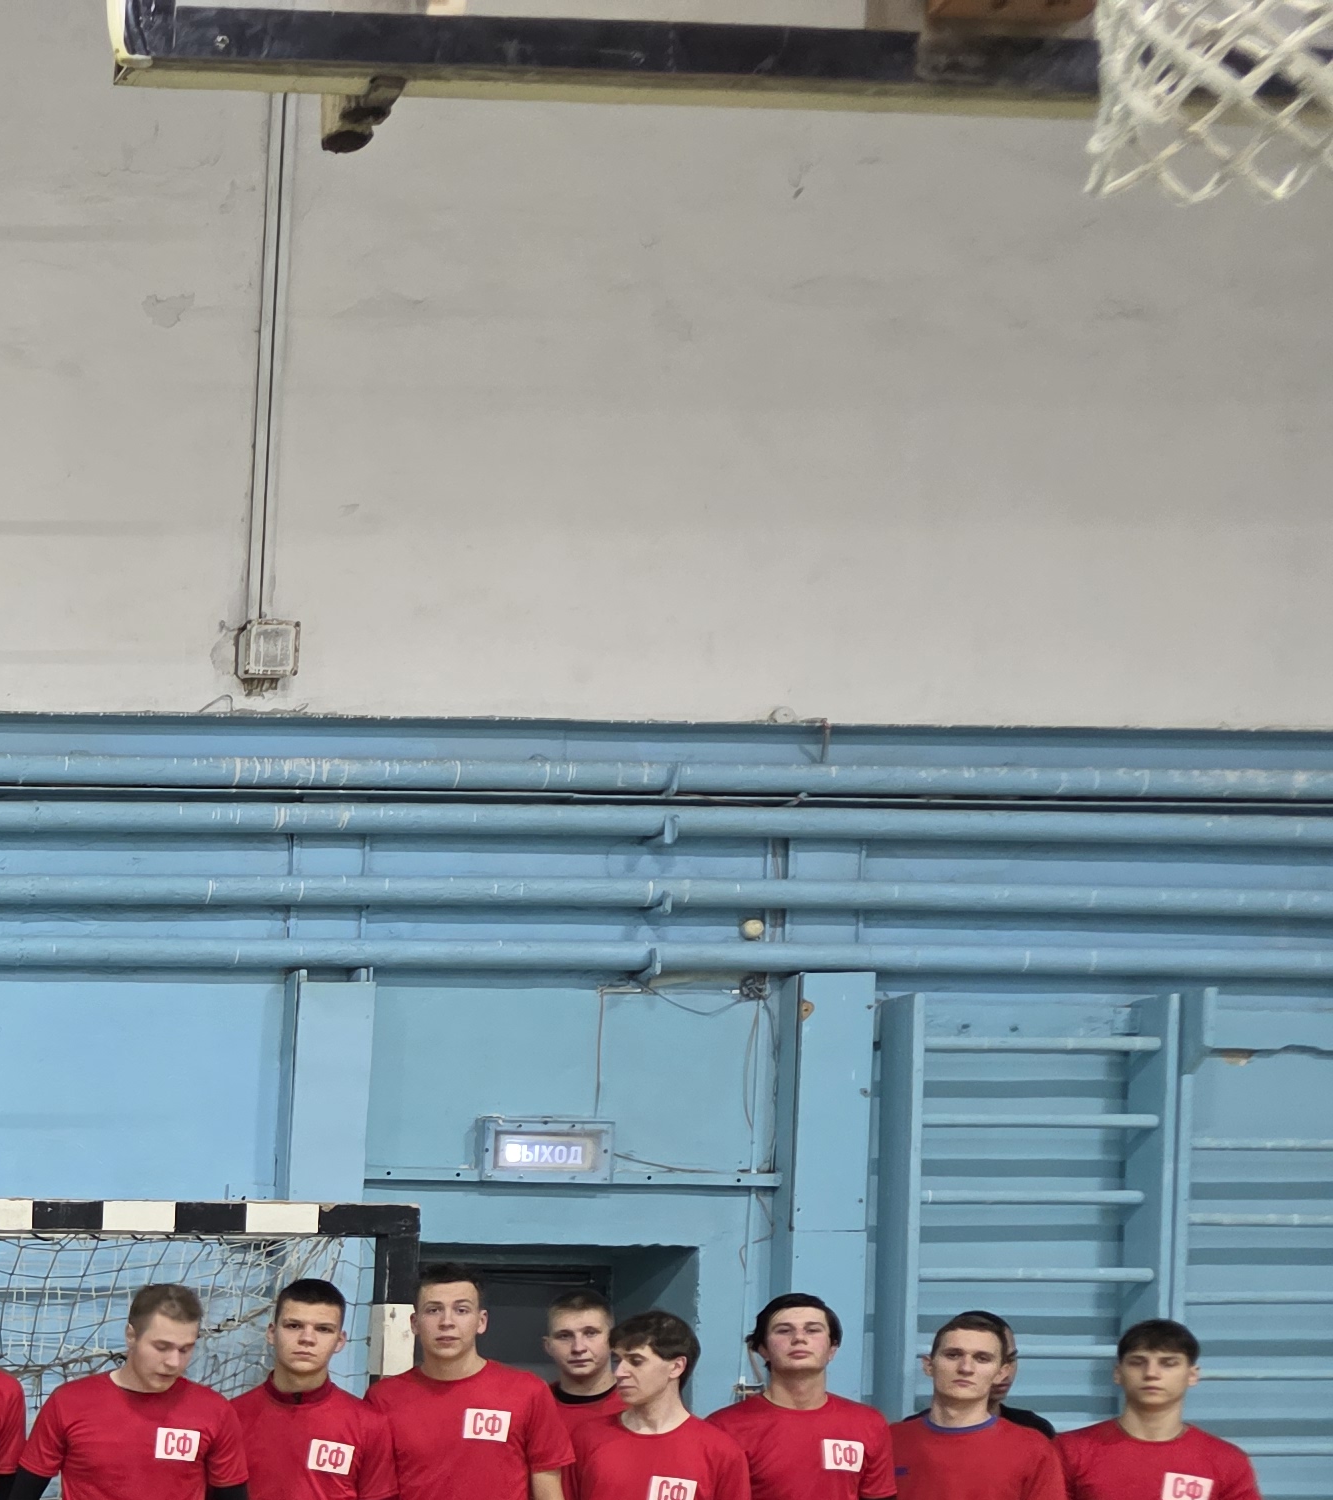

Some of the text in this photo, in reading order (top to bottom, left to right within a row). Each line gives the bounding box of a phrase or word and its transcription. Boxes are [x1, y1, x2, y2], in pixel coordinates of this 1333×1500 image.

[472, 1412, 502, 1437] СФ
[164, 1431, 193, 1457] СФ
[315, 1443, 346, 1469] СФ
[832, 1443, 858, 1467] СФ
[1172, 1477, 1203, 1500] СФ
